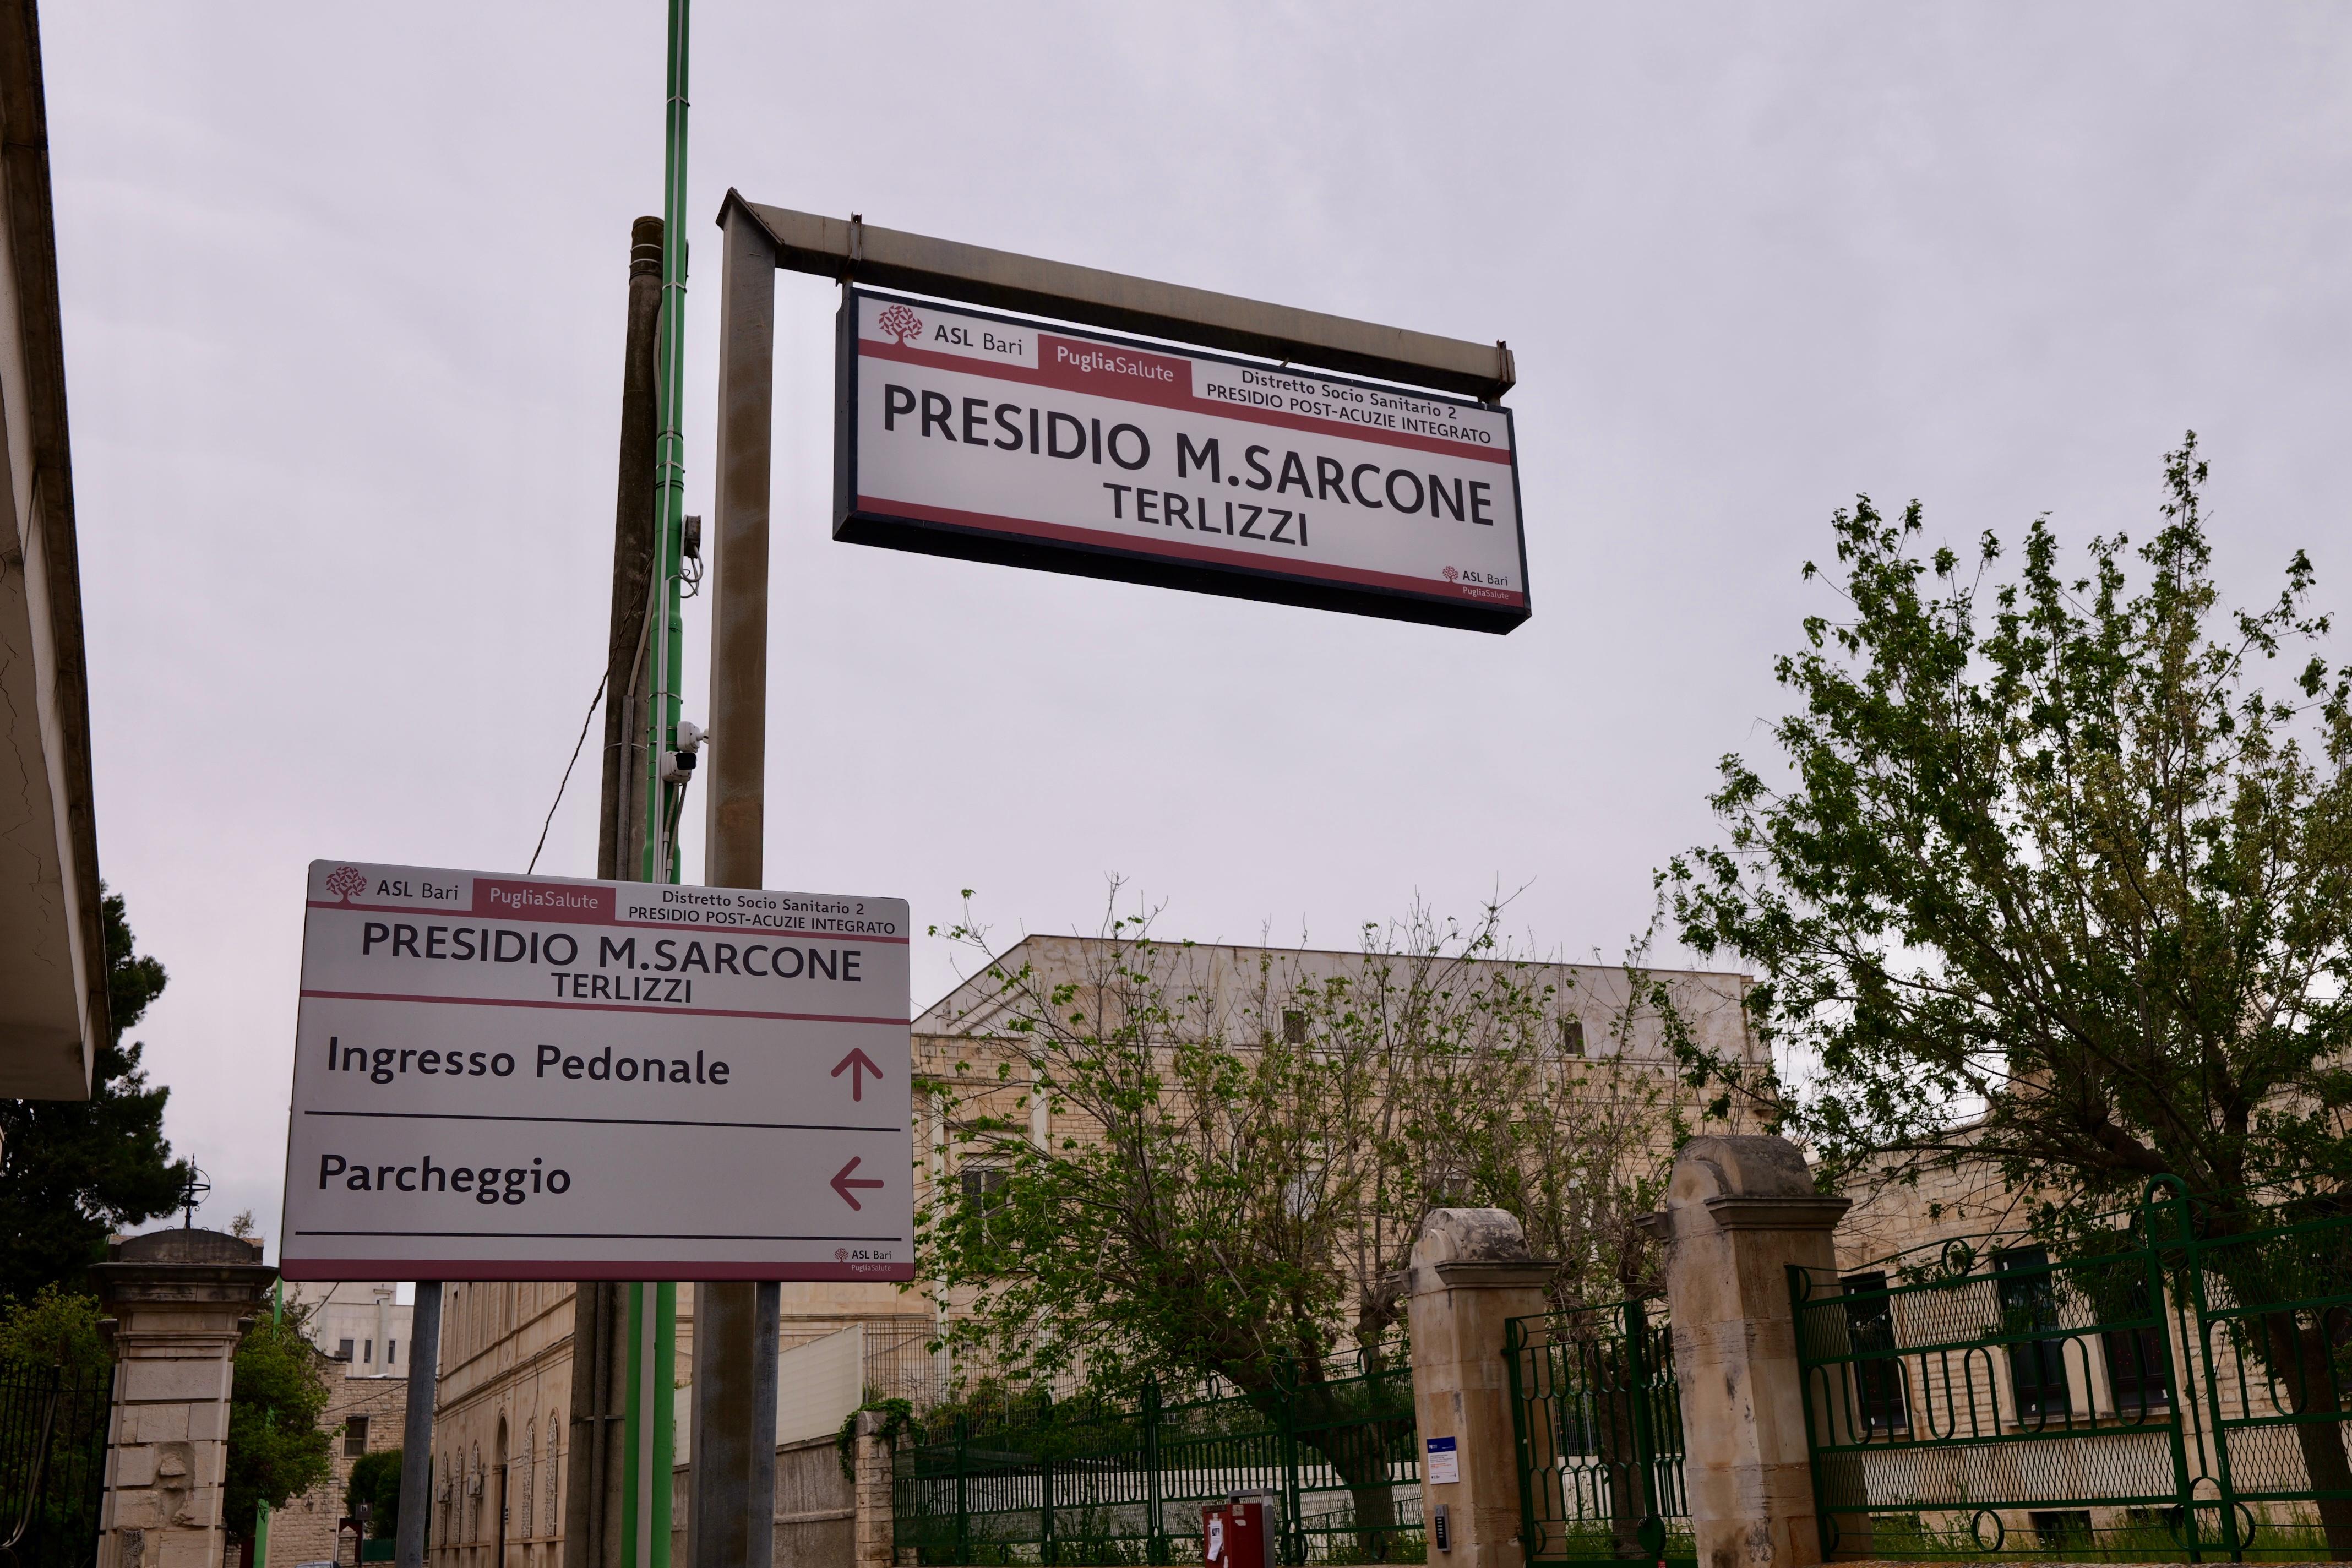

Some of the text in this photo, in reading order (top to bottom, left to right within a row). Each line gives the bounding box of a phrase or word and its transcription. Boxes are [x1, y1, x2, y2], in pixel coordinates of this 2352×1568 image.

[935, 325, 1021, 355] ASL Bari
[1058, 346, 1173, 381] PugliaSalute
[1243, 370, 1457, 420] Distretto Socio Sanitario 2
[885, 384, 1150, 470] PRESIDIO
[1207, 384, 1490, 443] PRESIDIO POST-ACUZIE INTEGRATO
[1103, 483, 1308, 546] TERLIZZI
[1462, 586, 1509, 600] PugliaSalute
[1463, 571, 1507, 586] ASL Bari
[377, 880, 458, 900] ASL Bari
[490, 888, 598, 908] PugliaSalute
[663, 891, 864, 914] Distretto Socio Sanitario 2
[629, 907, 895, 934] PRESIDIO POST-ACUZIE INTEGRATO
[363, 922, 578, 965] PRESIDIO
[551, 973, 691, 1003] TERLIZZI
[329, 1037, 729, 1085] Ingresso Pedonale
[319, 1155, 570, 1205] Parcheggio
[851, 1264, 891, 1273] PugliaSalute
[852, 1250, 891, 1259] ASL Bari
